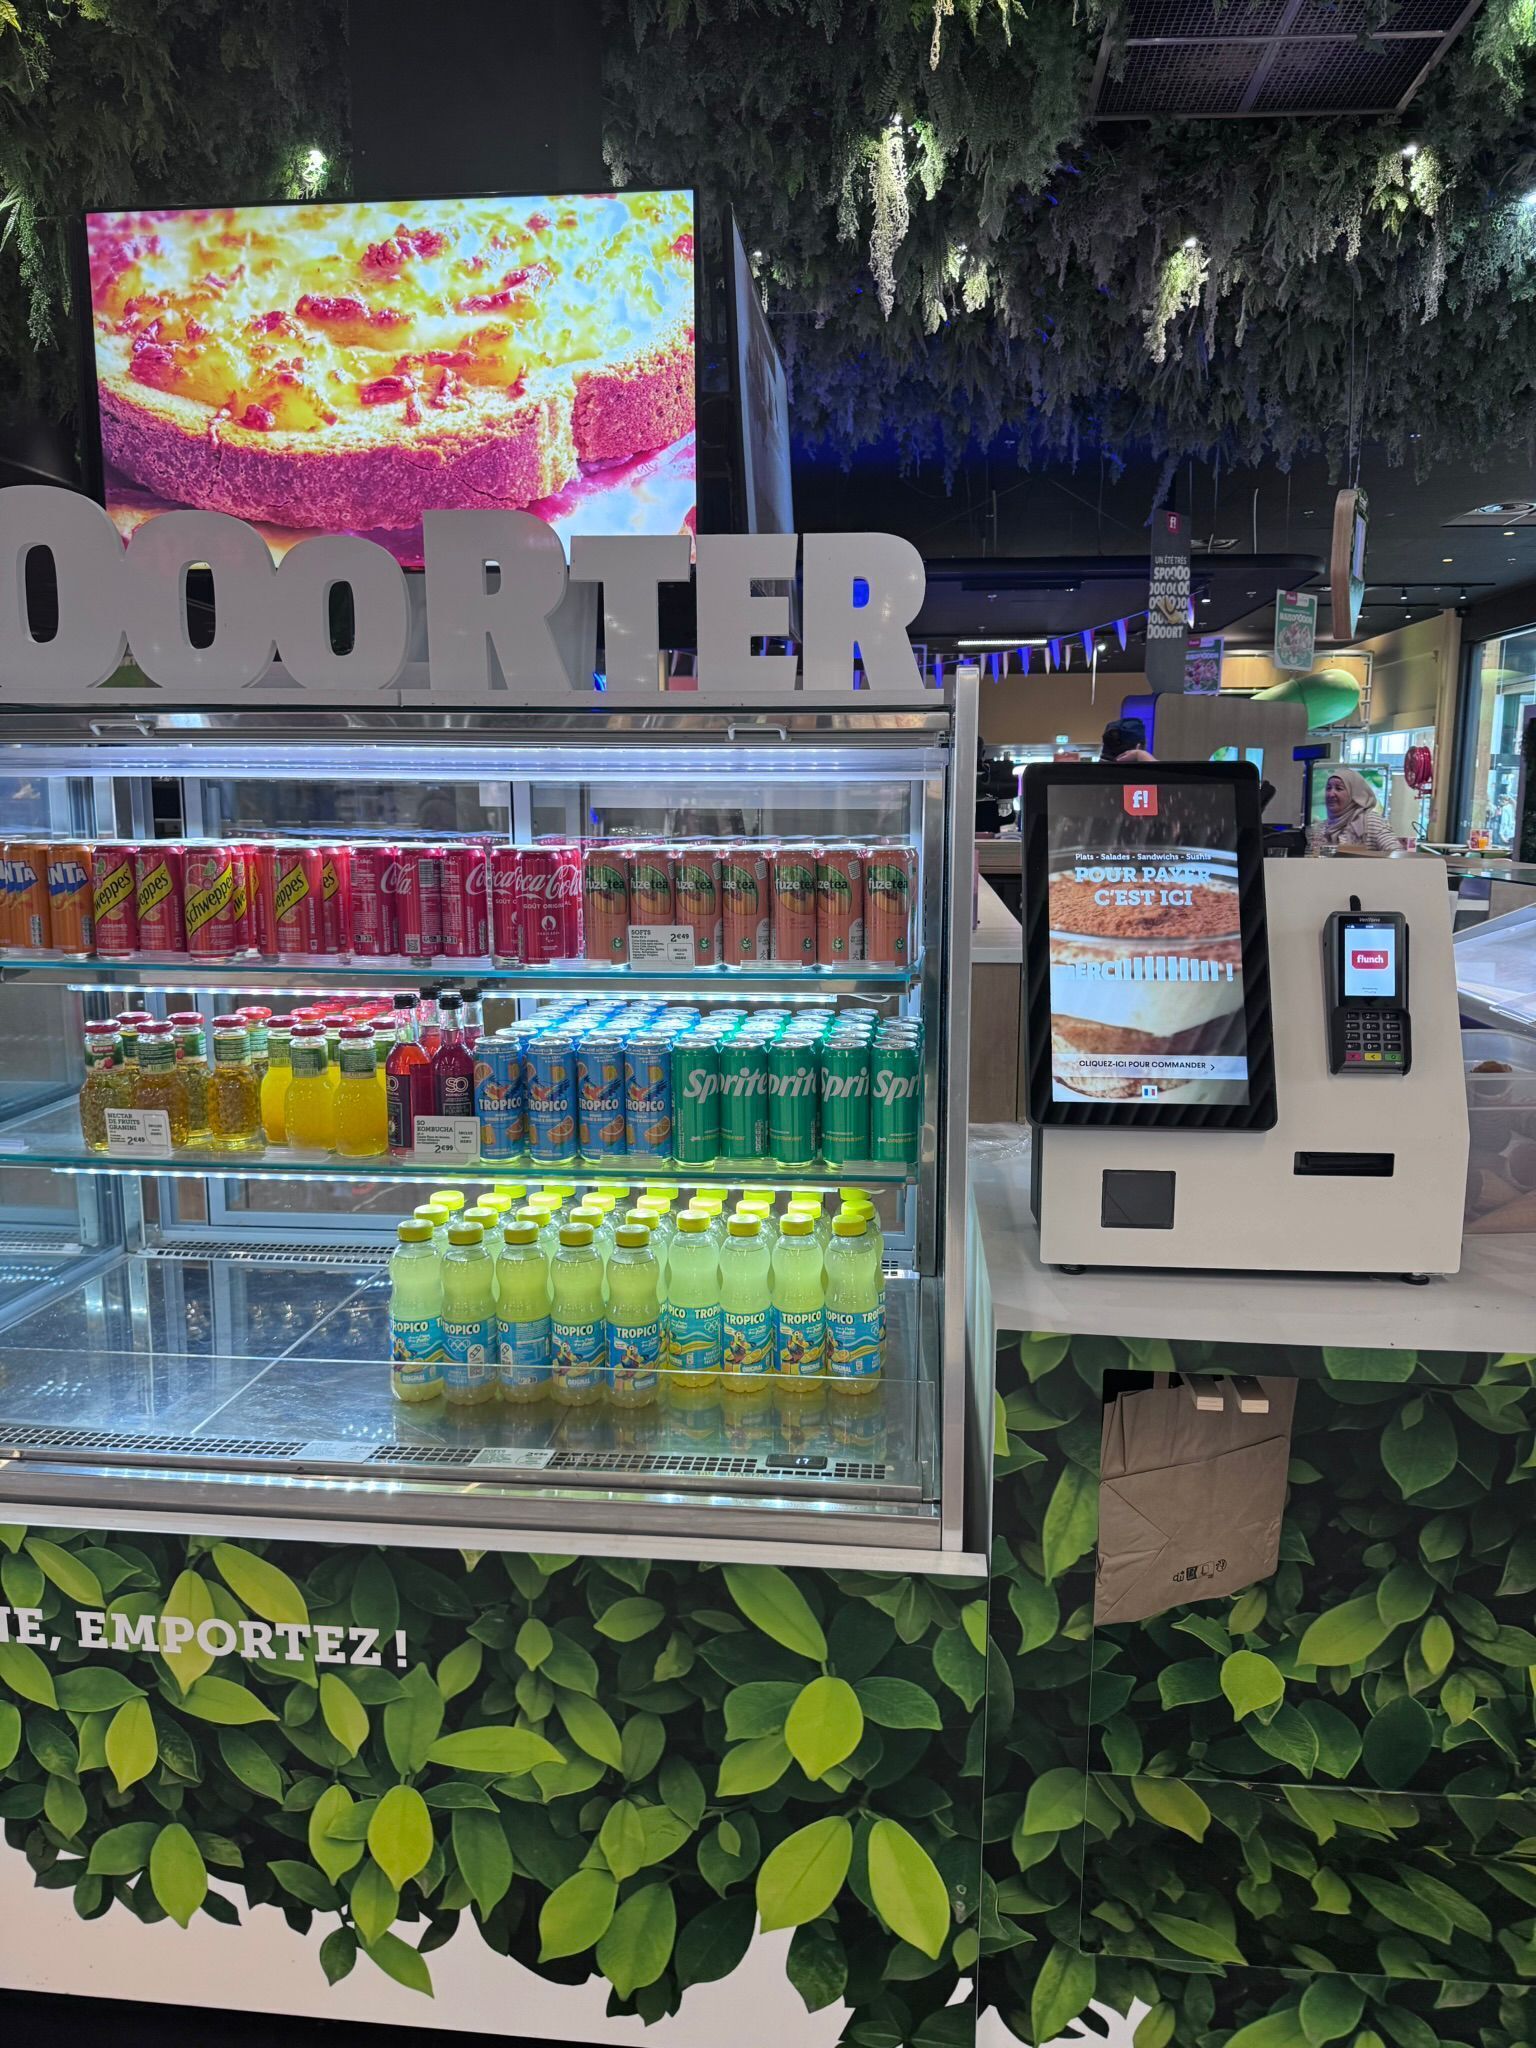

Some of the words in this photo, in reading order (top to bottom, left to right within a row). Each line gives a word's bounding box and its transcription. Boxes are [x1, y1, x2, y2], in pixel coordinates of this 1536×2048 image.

[1101, 853, 1130, 861] Salades
[1137, 853, 1179, 861] Sandwichs
[1074, 867, 1138, 883] POUR
[1142, 867, 1212, 884] PAYER
[1094, 890, 1155, 906] C'EST
[1160, 890, 1193, 906] ICI
[1356, 954, 1384, 964] flunch
[1079, 1059, 1127, 1068] CLIQUEZ-ICI
[1128, 1060, 1150, 1068] POUR
[1151, 1061, 1206, 1070] COMMANDER
[446, 1076, 469, 1093] SO
[725, 1312, 766, 1326] TROPICO
[781, 1310, 822, 1325] TROPICO
[553, 1322, 594, 1337] TROPICO
[616, 1323, 657, 1339] TROPICO
[76, 1610, 382, 1667] EMPORTEZ
